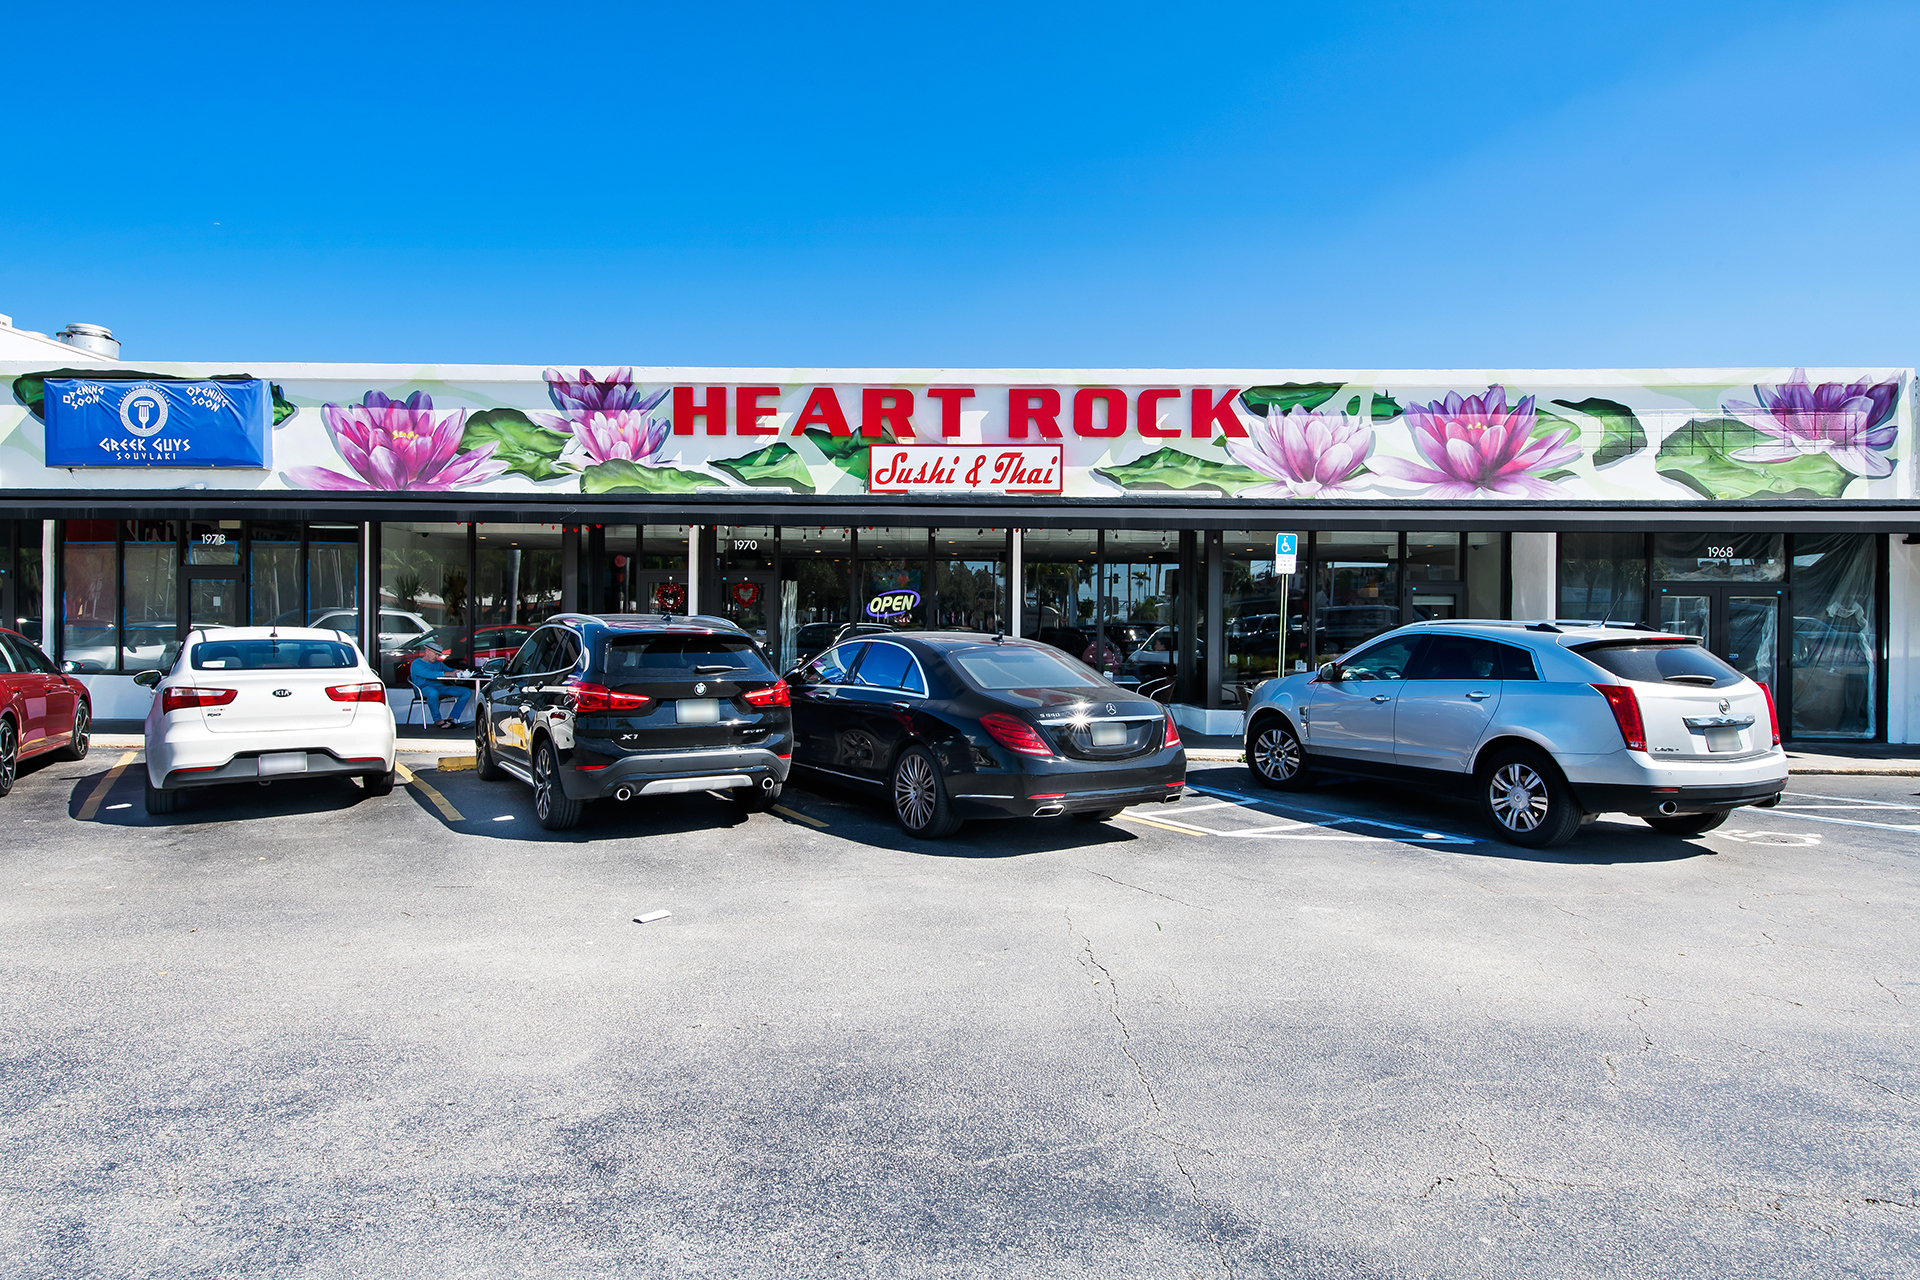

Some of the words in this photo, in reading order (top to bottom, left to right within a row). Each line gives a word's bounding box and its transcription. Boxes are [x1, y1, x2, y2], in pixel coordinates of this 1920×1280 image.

[63, 386, 104, 404] OPENING
[71, 394, 99, 410] SOON
[186, 386, 228, 408] OPENING
[191, 396, 220, 412] SOON
[673, 386, 976, 438] HEART
[1008, 388, 1249, 439] ROCK
[99, 437, 147, 453] GREEK
[152, 437, 191, 453] GUYS
[116, 452, 176, 461] SOUVLAKI
[874, 452, 960, 485] Sushi
[965, 454, 987, 488] &
[990, 452, 1058, 485] Thai
[201, 533, 226, 546] 1978
[733, 539, 758, 551] 1970
[1707, 546, 1734, 558] 1968
[870, 594, 915, 613] OPEN
[620, 733, 639, 741] X1
